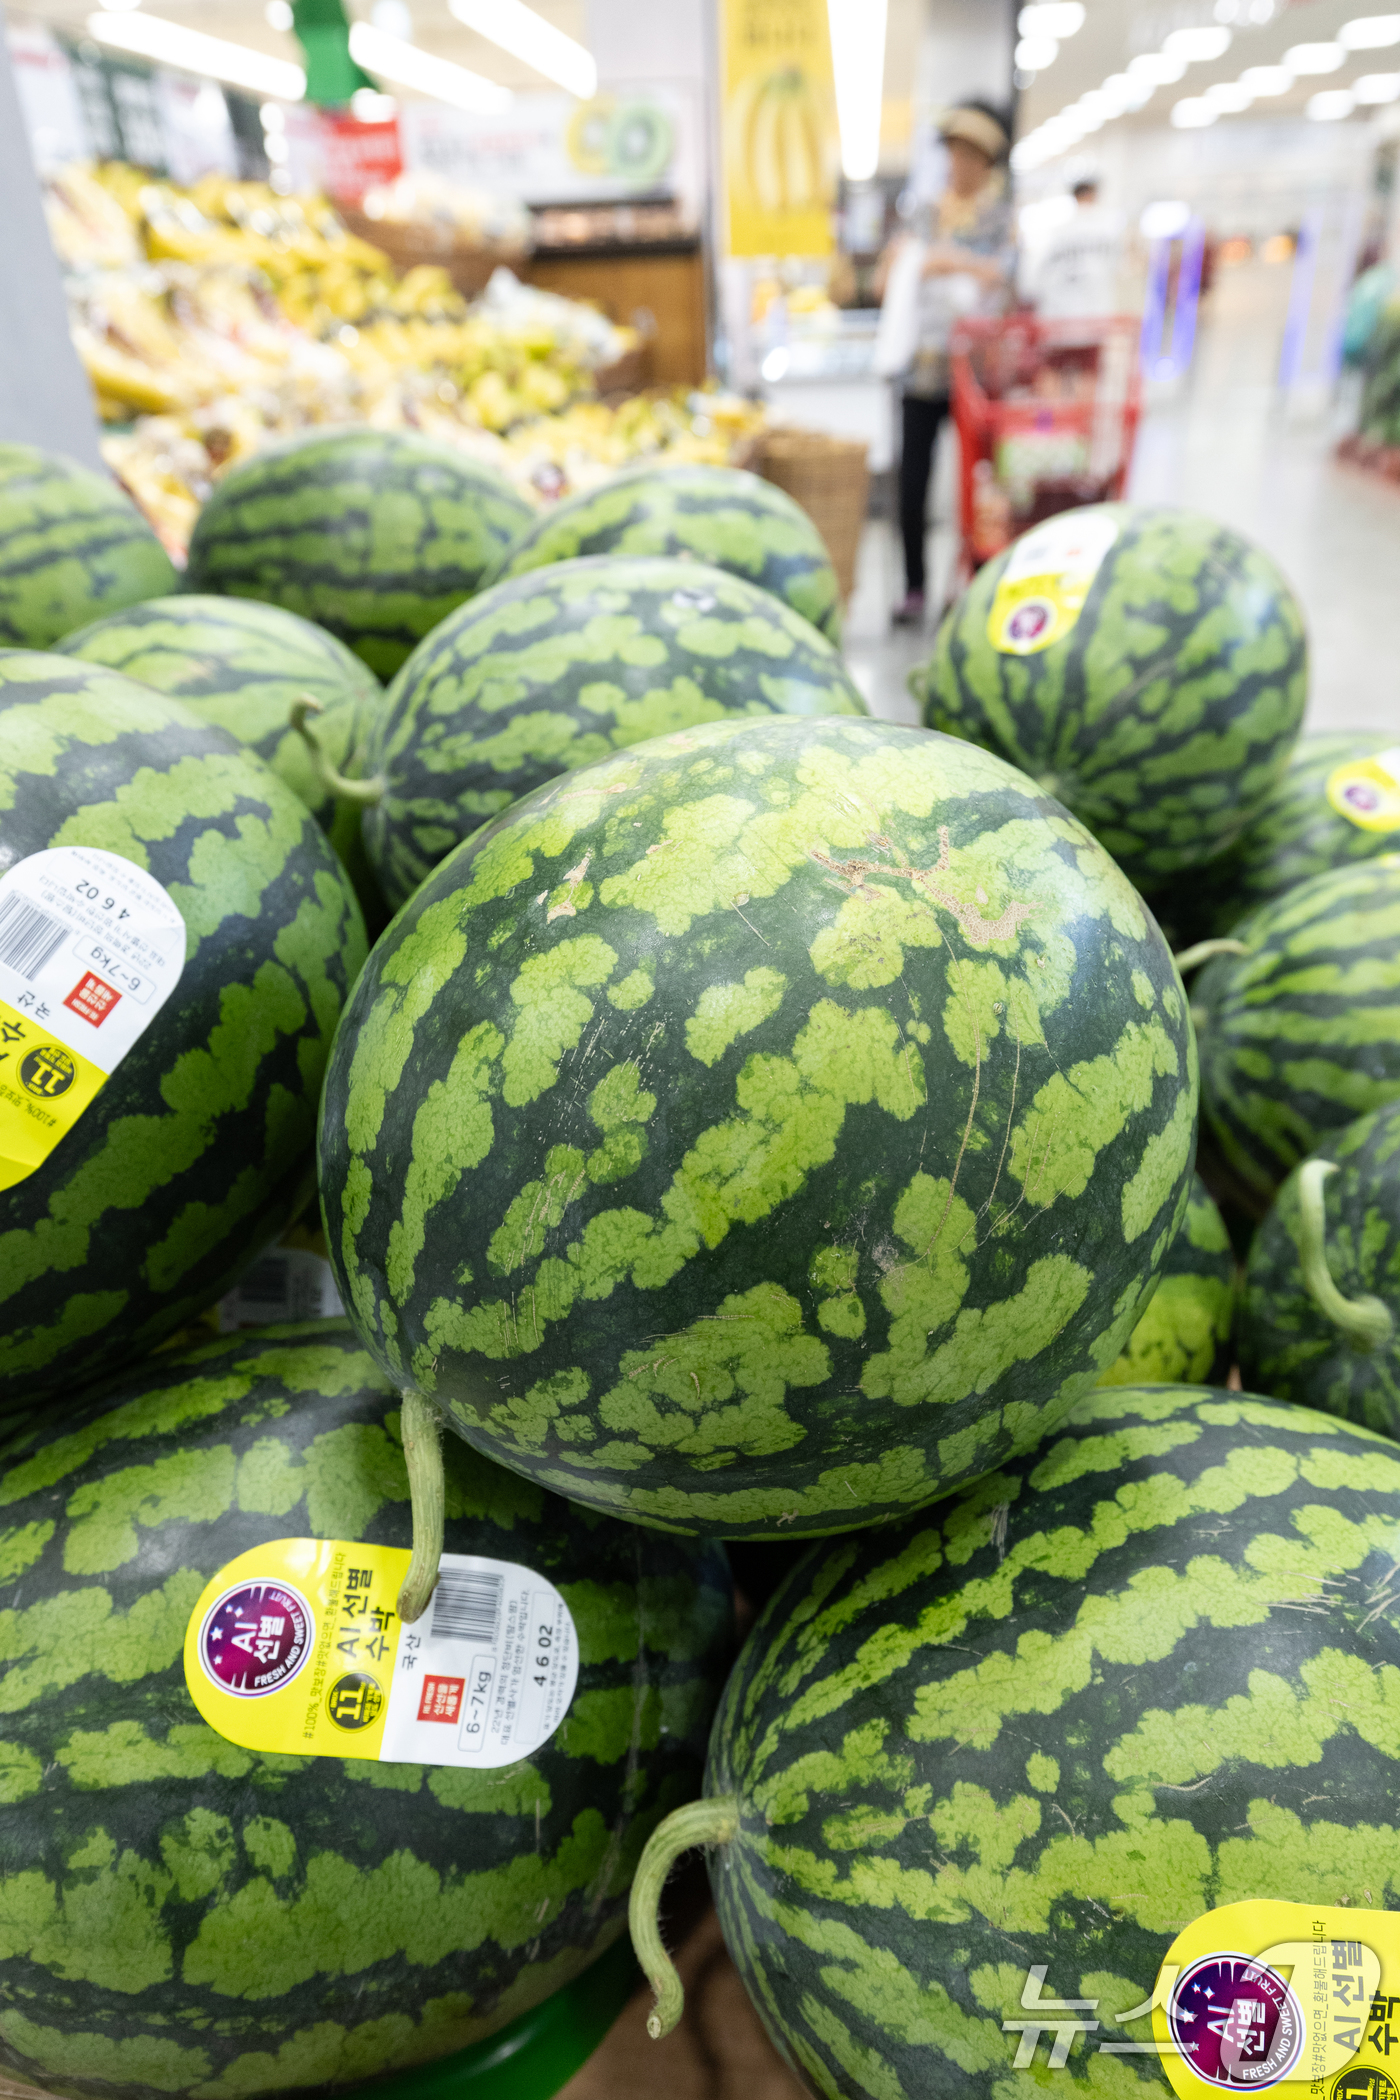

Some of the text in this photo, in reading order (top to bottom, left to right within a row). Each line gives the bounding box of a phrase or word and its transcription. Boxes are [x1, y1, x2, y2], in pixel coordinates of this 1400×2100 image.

[74, 877, 131, 922] 4 6 02
[87, 944, 144, 992] 6~7kg
[17, 990, 51, 1020] 국산
[31, 1060, 65, 1094] 11
[337, 1568, 373, 1658] AI 선별
[365, 1606, 395, 1661] 수박
[231, 1622, 258, 1653] AI
[253, 1615, 285, 1664] 선별
[254, 1591, 304, 1687] FRESH AND SWEET FRUIT
[401, 1633, 421, 1670] 국산
[533, 1625, 552, 1687] 4 6 02
[336, 1688, 364, 1720] 11
[434, 1683, 448, 1715] 신선을
[446, 1684, 459, 1717] 새롭게
[466, 1671, 491, 1734] 6~7kg
[1331, 1940, 1364, 2053] AI 선별
[1207, 2004, 1234, 2043] AI
[1237, 1999, 1265, 2056] 선별
[1242, 1969, 1293, 2080] FRESH AND SWEET FRUIT
[1368, 1990, 1400, 2056] 수박
